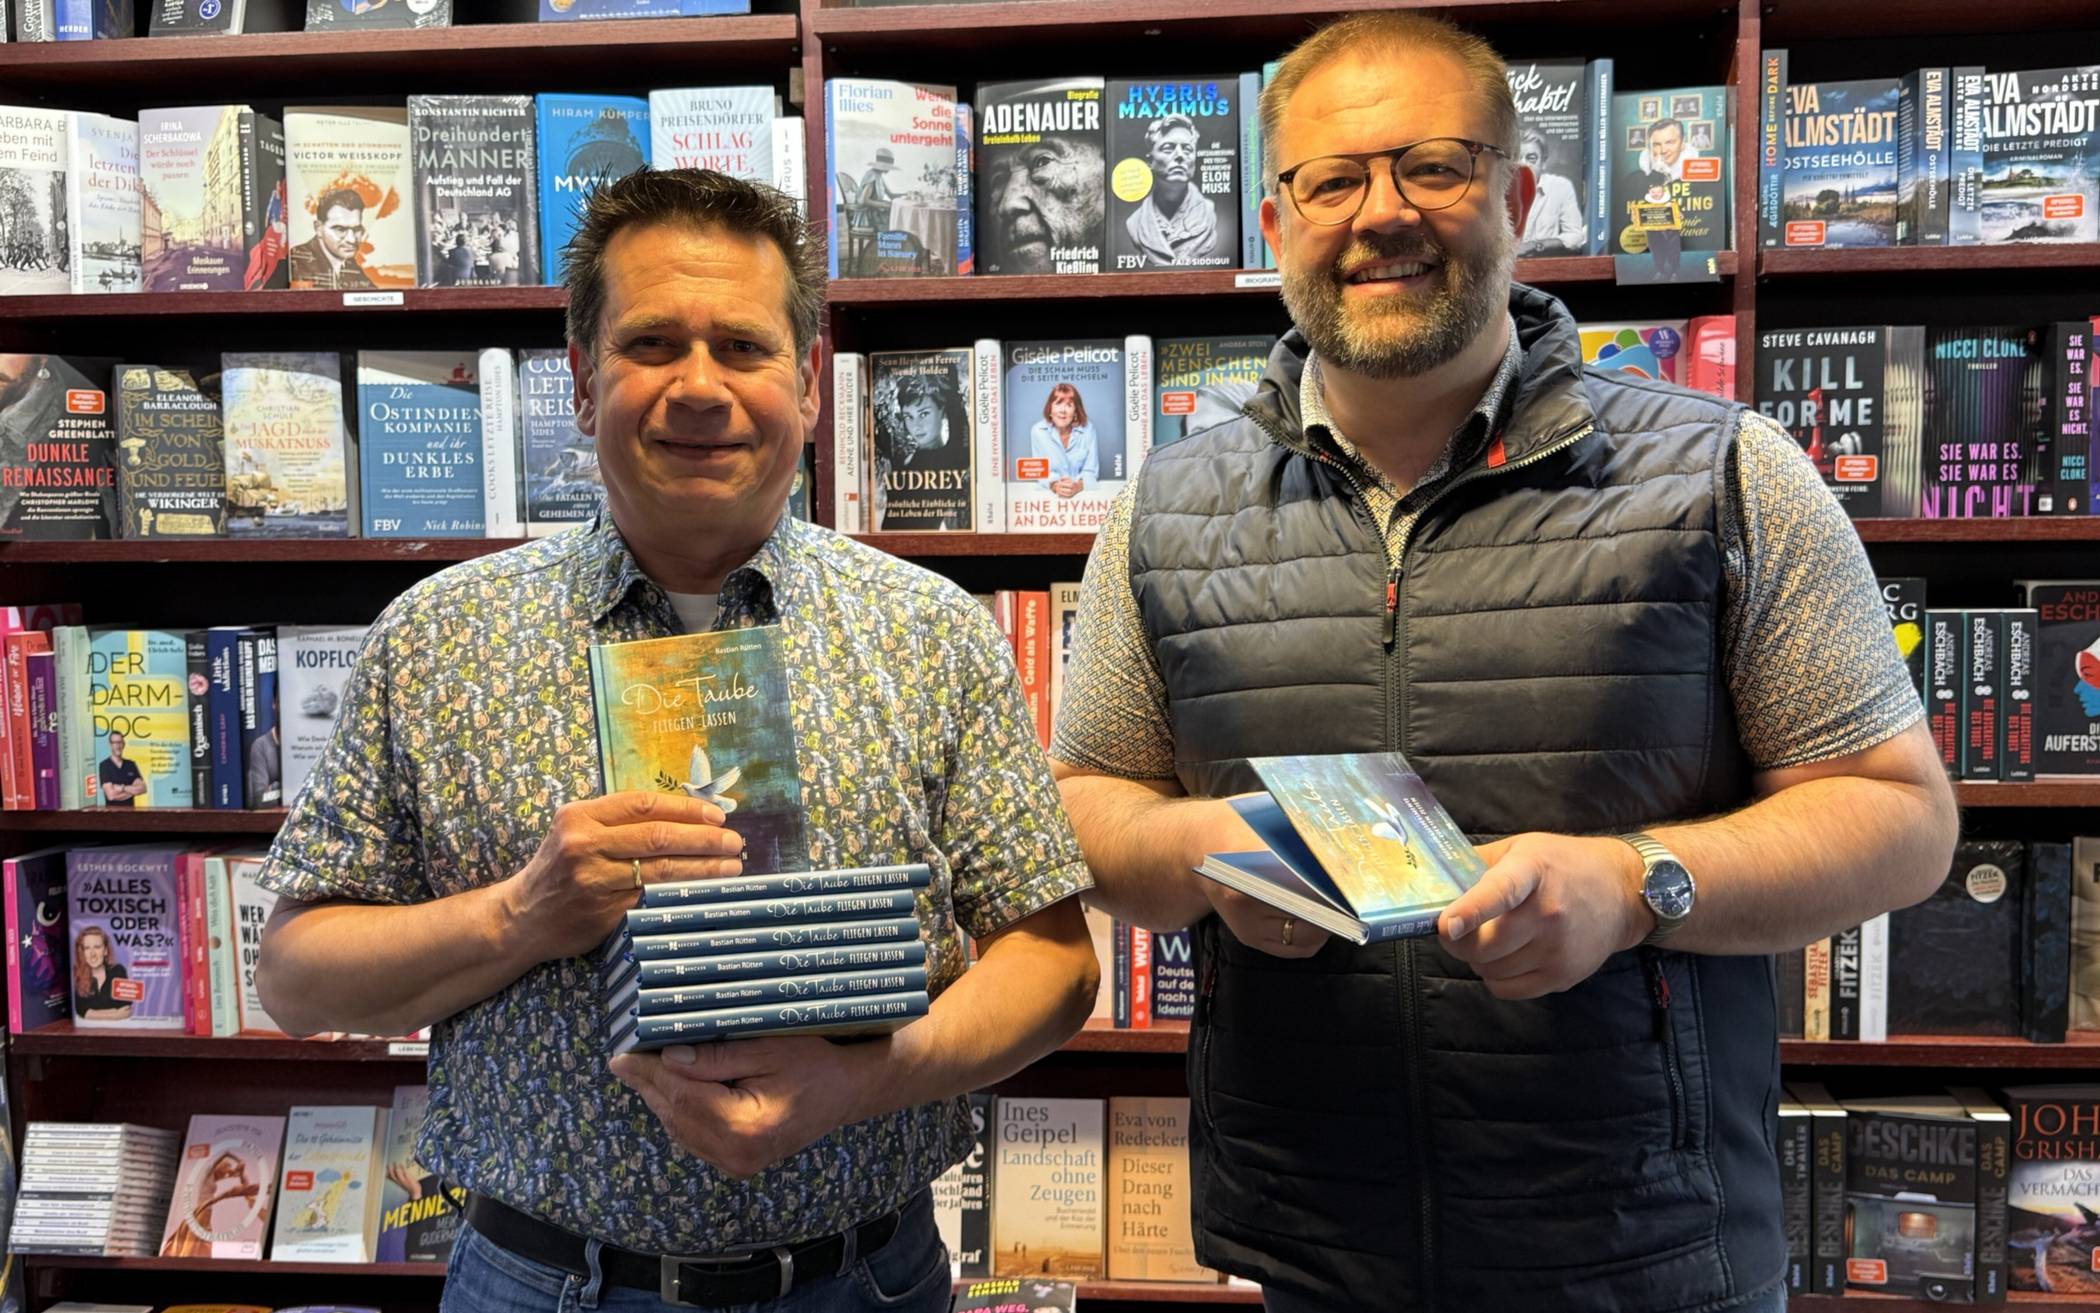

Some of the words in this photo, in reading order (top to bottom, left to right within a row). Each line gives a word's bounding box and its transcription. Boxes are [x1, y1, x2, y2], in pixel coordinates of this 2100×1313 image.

[1926, 71, 1942, 93] EVA
[2062, 74, 2098, 83] AKTE
[839, 84, 892, 98] Florian
[916, 88, 951, 101] Wenn
[1128, 84, 1218, 103] HYBRIS
[2032, 82, 2098, 94] NORDSEE
[415, 108, 479, 116] KONSTANTIN
[482, 108, 525, 116] RICHTER
[690, 100, 732, 111] BRUNO
[839, 99, 874, 112] Illies
[932, 105, 951, 117] die
[1119, 98, 1229, 119] MAXIMUS
[553, 108, 592, 118] HIRAM
[598, 109, 650, 120] KÜMPER
[661, 114, 764, 127] PREISENDÖRFER
[982, 102, 1099, 133] ADENAUER
[161, 121, 182, 131] IRINA
[912, 117, 952, 130] Sonne
[1925, 95, 1942, 151] ALMSTÄDT
[1964, 99, 1981, 152] ALMSTÄDT
[144, 132, 201, 144] SCHERBAKOWA
[419, 126, 528, 142] Dreihundert
[890, 134, 952, 146] untergeht
[33, 136, 53, 146] mit
[672, 132, 752, 150] SCHLAG
[2003, 141, 2039, 151] LETZTE
[2043, 138, 2088, 148] PREDIGT
[22, 149, 57, 162] Feind
[419, 145, 528, 168] MÄNNER
[426, 175, 463, 187] Aufstieg
[466, 175, 483, 185] und
[1202, 172, 1230, 182] ELON
[437, 187, 493, 197] Deutschland
[496, 188, 511, 197] AG
[1202, 183, 1230, 193] MUSK
[1050, 247, 1099, 260] Friedrich
[193, 257, 224, 265] Moskauer
[1056, 261, 1099, 274] Kießling
[1117, 256, 1147, 269] FBV
[187, 266, 230, 275] Erinnerungen
[1762, 333, 1801, 348] STEVE
[1807, 331, 1876, 345] CAVANAGH
[2069, 335, 2083, 346] SIE
[1012, 347, 1060, 364] Gisèle
[1063, 346, 1119, 363] Pelicot
[1936, 340, 1976, 358] NICCI
[2066, 349, 2085, 360] WAR
[1045, 366, 1074, 374] SCHAM
[1161, 357, 1267, 372] MENSCHEN
[979, 354, 988, 393] Pelicot
[1037, 374, 1059, 382] SEITE
[1161, 372, 1200, 387] SIND
[1206, 373, 1220, 386] IN
[1773, 357, 1863, 392] KILL
[390, 387, 414, 399] Die
[2068, 382, 2082, 394] SIE
[143, 402, 216, 410] BARRACLOUGH
[2066, 396, 2084, 407] WAR
[1829, 398, 1874, 427] ME
[58, 420, 106, 429] STEPHEN
[135, 414, 154, 427] IM
[249, 422, 301, 437] JAGD
[384, 422, 472, 434] KOMPANIE
[2062, 423, 2088, 434] NICHT.
[162, 434, 200, 448] VON
[235, 439, 331, 449] MUSKATNUSS
[27, 444, 89, 462] DUNKLE
[383, 452, 474, 464] DUNKLES
[1940, 443, 1962, 461] SIE
[1969, 444, 1997, 460] WAR
[2003, 443, 2023, 460] ES.
[158, 454, 206, 467] GOLD
[2062, 456, 2085, 466] NICCI
[2, 468, 114, 487] RENAISSANCE
[405, 467, 455, 479] ERBE
[1940, 463, 1962, 481] SIE
[1969, 463, 1997, 481] WAR
[2003, 463, 2018, 480] ES
[2060, 468, 2086, 480] CLOKE
[883, 470, 966, 491] AUDREY
[148, 499, 220, 508] WIKINGER
[1015, 501, 1050, 513] EINE
[374, 519, 402, 531] FBV
[1015, 515, 1033, 526] AN
[1040, 514, 1065, 526] DAS
[739, 643, 762, 652] Rütten
[1027, 640, 1036, 657] als
[1934, 621, 1947, 686] ESCHBACH
[1973, 617, 1986, 682] ESCHBACH
[2010, 622, 2023, 686] ESCHBACH
[91, 652, 145, 675] DER
[90, 684, 184, 706] DARM-
[621, 683, 687, 715] Die
[675, 672, 759, 709] Taube
[93, 715, 152, 738] DOC
[654, 717, 694, 733] FLIEGEN
[702, 711, 737, 731] LASSEN
[77, 864, 113, 872] ESTHER
[117, 864, 169, 873] BOCKWYT
[1970, 870, 2000, 881] FITZEK
[721, 885, 744, 894] Bastian
[784, 877, 815, 893] Die
[810, 873, 849, 891] Taube
[853, 875, 882, 886] FLIEGEN
[885, 873, 908, 884] LASSEN
[77, 899, 166, 913] TOXISCH
[704, 911, 728, 919] Bastian
[767, 903, 798, 918] Die
[793, 900, 834, 915] Taube
[837, 900, 866, 911] FLIEGEN
[869, 898, 893, 909] LASSEN
[110, 917, 159, 930] ODER
[710, 939, 734, 947] Bastian
[773, 930, 804, 946] Die
[800, 926, 840, 943] Taube
[843, 928, 871, 939] FLIEGEN
[874, 925, 898, 937] LASSEN
[1817, 950, 1828, 987] FITZEK
[1839, 930, 1859, 998] FITZEK
[1158, 980, 1176, 989] auf
[1158, 992, 1187, 1002] nach
[1003, 1102, 1049, 1122] Ines
[1114, 1112, 1142, 1128] Eva
[1148, 1114, 1177, 1128] von
[1003, 1122, 1078, 1148] Geipel
[1114, 1131, 1186, 1147] Redecker
[1002, 1149, 1097, 1167] Landschaft
[1122, 1158, 1173, 1174] Dieser
[1051, 1168, 1097, 1184] ohne
[1865, 1165, 1899, 1180] DAS
[1904, 1170, 1957, 1185] CAMP
[1030, 1184, 1097, 1206] Zeugen
[1122, 1179, 1174, 1198] Drang
[1122, 1200, 1162, 1215] nach
[1122, 1221, 1168, 1238] Härte
